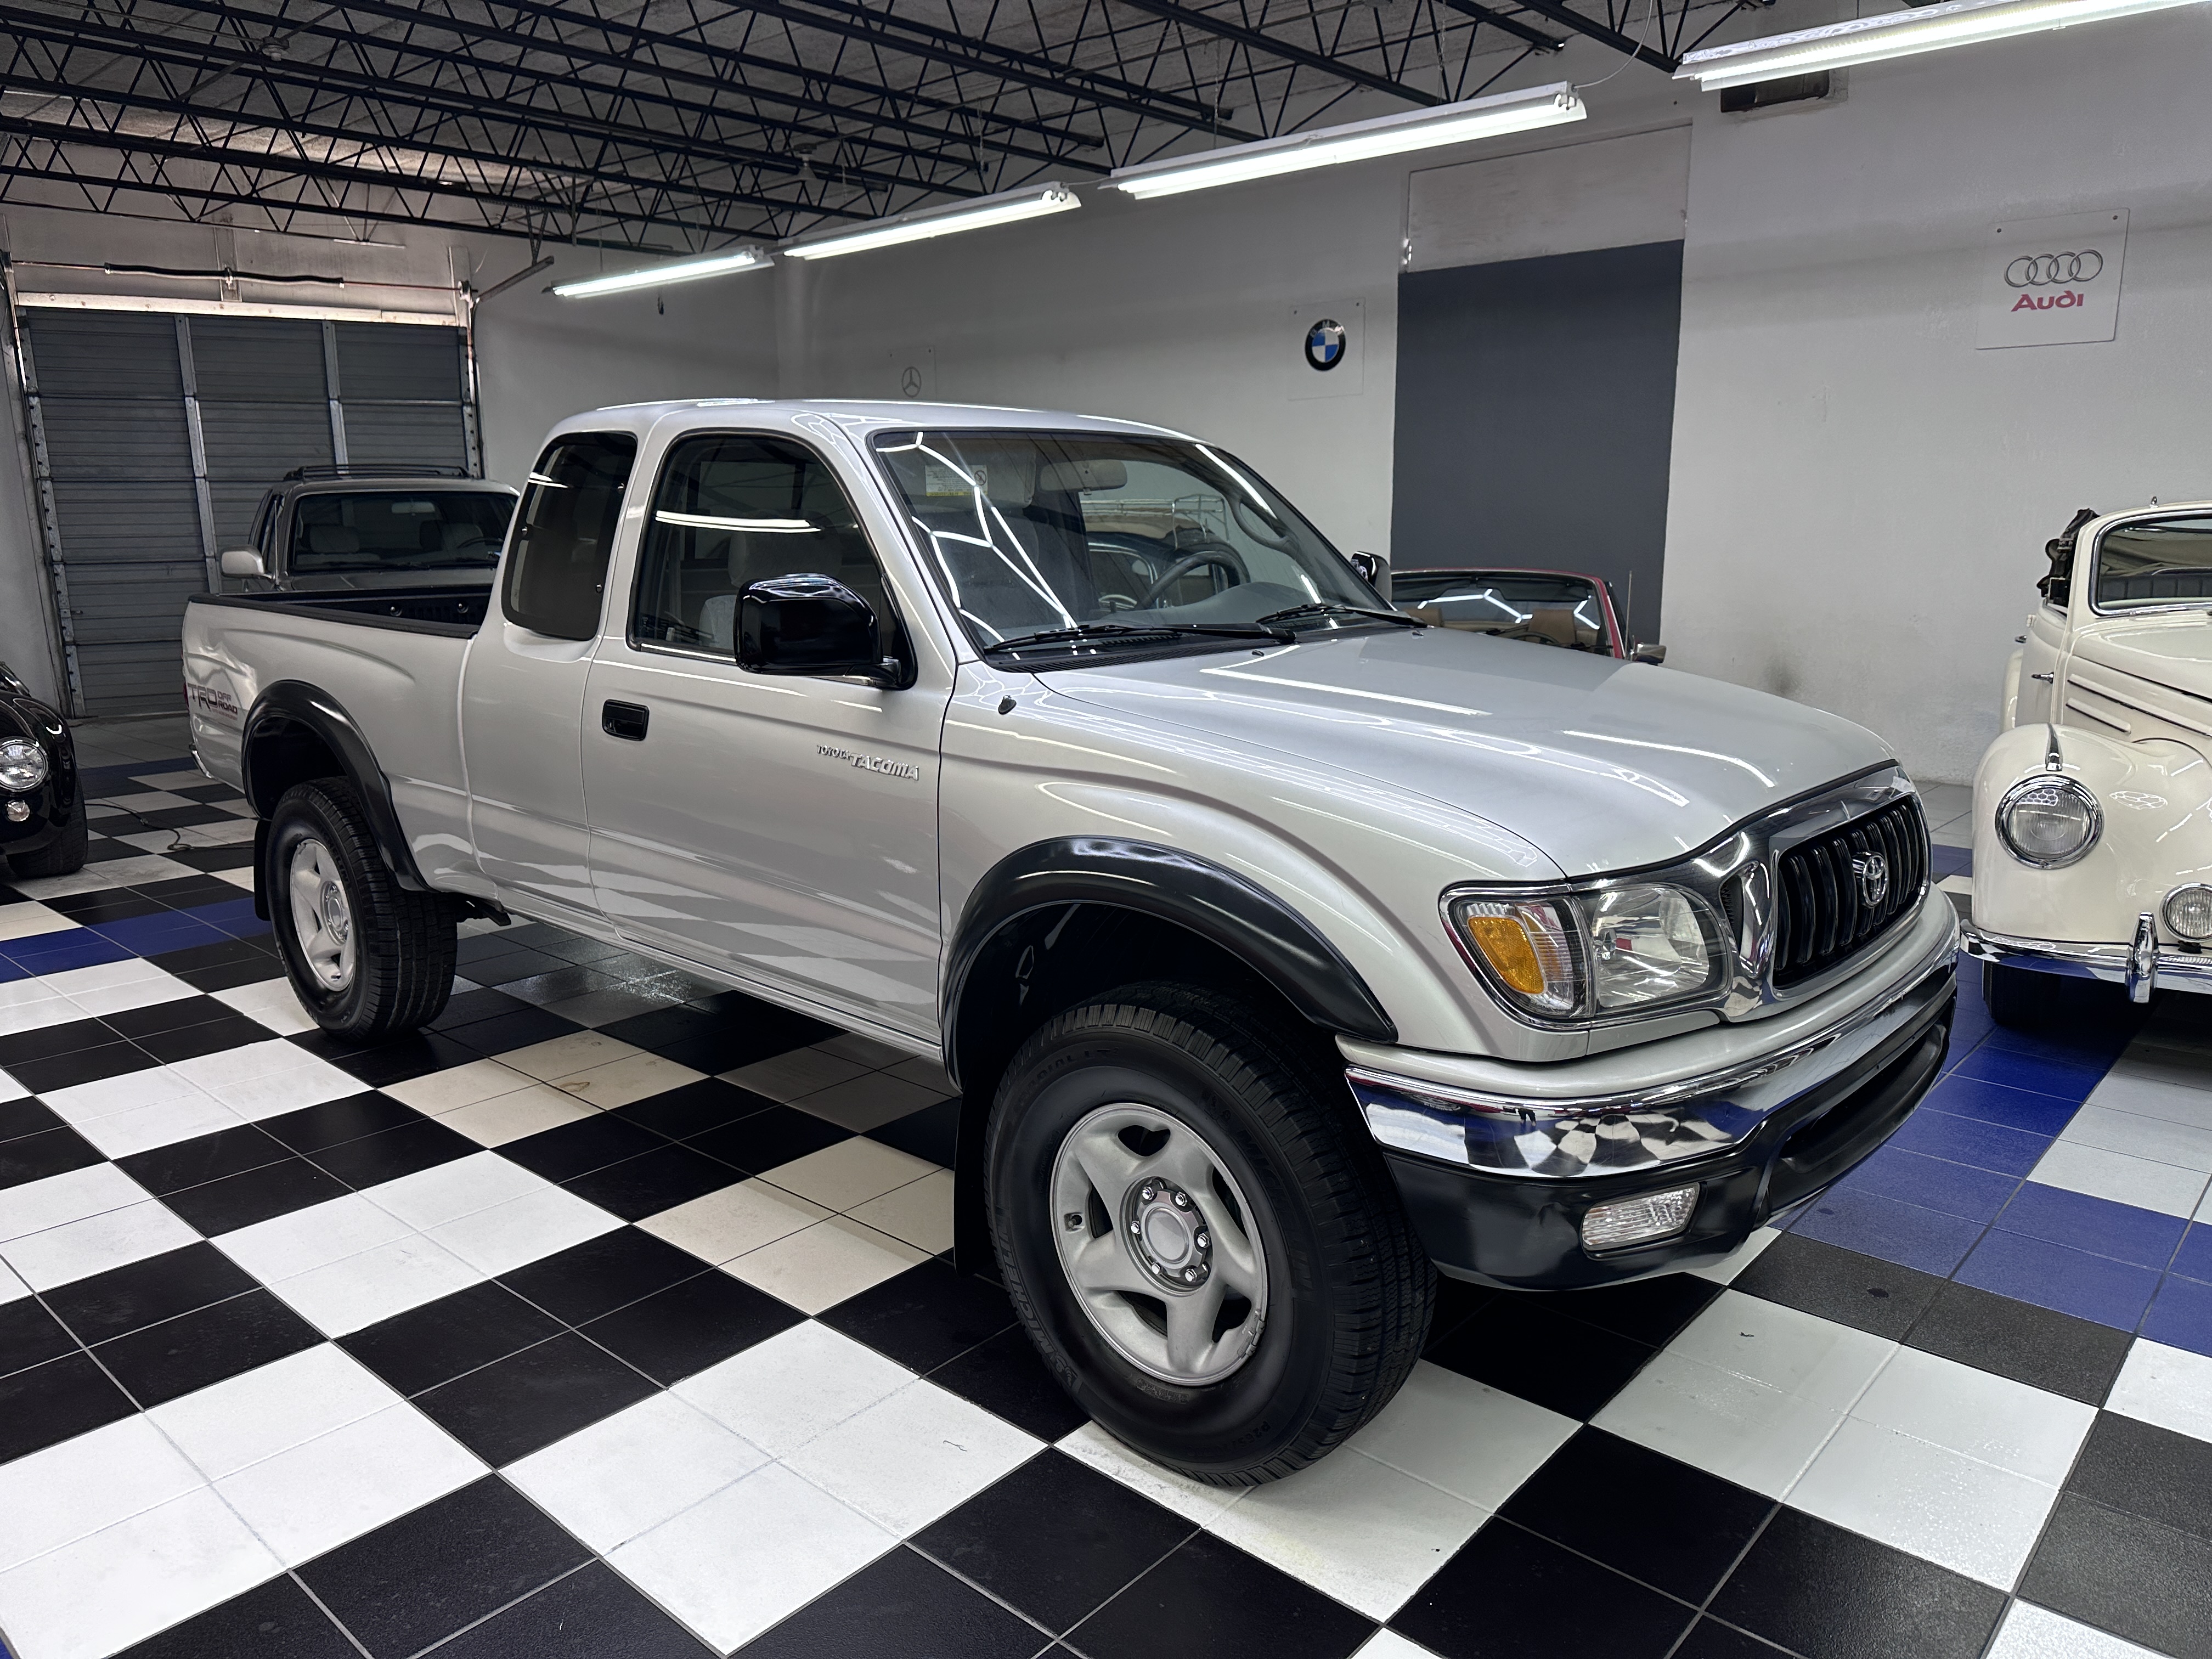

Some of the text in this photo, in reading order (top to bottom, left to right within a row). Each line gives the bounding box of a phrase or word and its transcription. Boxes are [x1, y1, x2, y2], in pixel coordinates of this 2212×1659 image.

[2011, 290, 2084, 312] Audi
[187, 682, 232, 711] TRD OFF
[218, 700, 238, 715] ROAD
[817, 744, 919, 781] TOYOTA TACOMA
[997, 1216, 1055, 1355] MICHELIN
